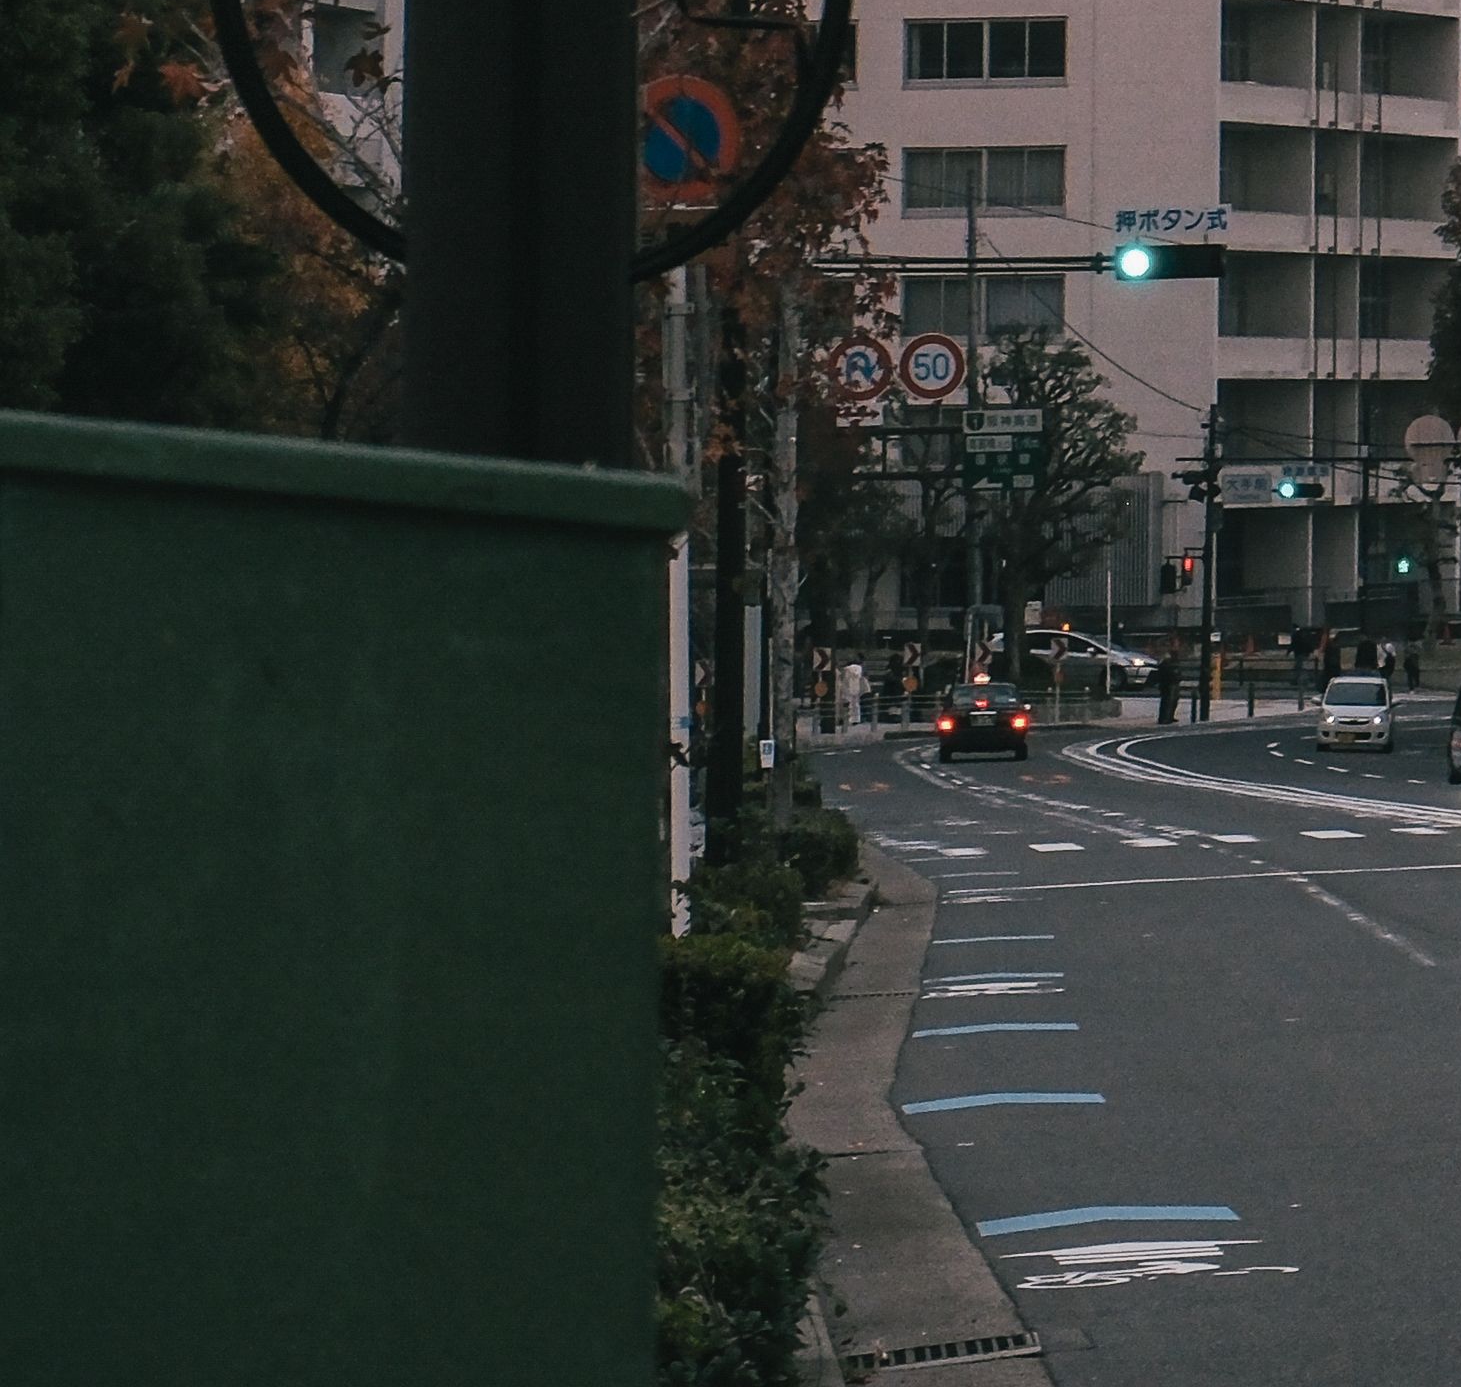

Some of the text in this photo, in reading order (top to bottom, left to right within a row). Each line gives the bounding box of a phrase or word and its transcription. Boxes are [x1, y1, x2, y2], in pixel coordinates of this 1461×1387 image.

[1115, 208, 1228, 232] 押ボタン式
[914, 353, 949, 381] 50
